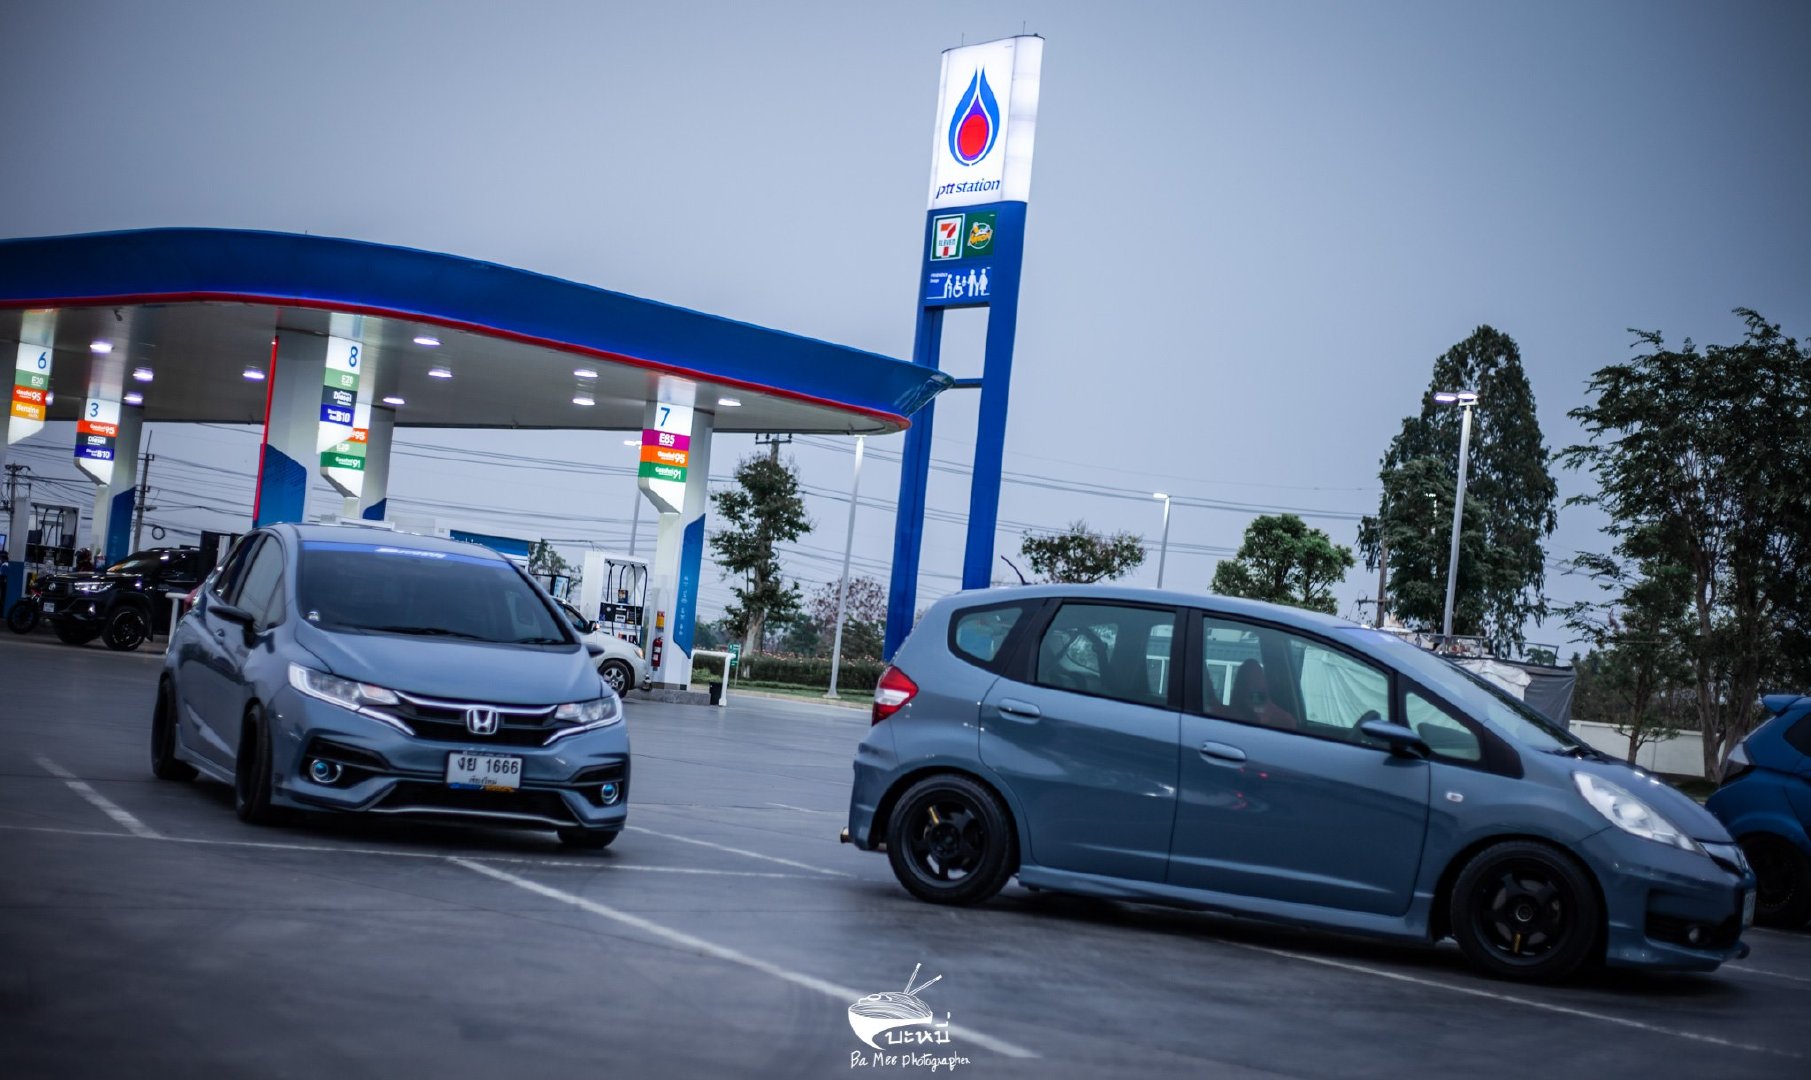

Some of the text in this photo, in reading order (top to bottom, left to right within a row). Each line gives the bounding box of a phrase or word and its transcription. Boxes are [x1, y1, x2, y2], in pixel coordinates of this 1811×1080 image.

[935, 177, 1001, 199] ptt station
[37, 351, 47, 370] 6
[349, 346, 358, 367] 8
[31, 376, 44, 385] E20
[341, 375, 354, 385] E20
[31, 391, 42, 402] 95
[89, 402, 99, 418] 3
[336, 412, 351, 423] B10
[660, 406, 671, 427] 7
[105, 426, 115, 435] 95
[354, 430, 366, 441] 95
[659, 433, 675, 444] E85
[96, 450, 111, 459] B10
[674, 453, 686, 464] 95
[351, 458, 361, 469] 91
[673, 469, 682, 480] 91
[486, 758, 519, 774] 1666
